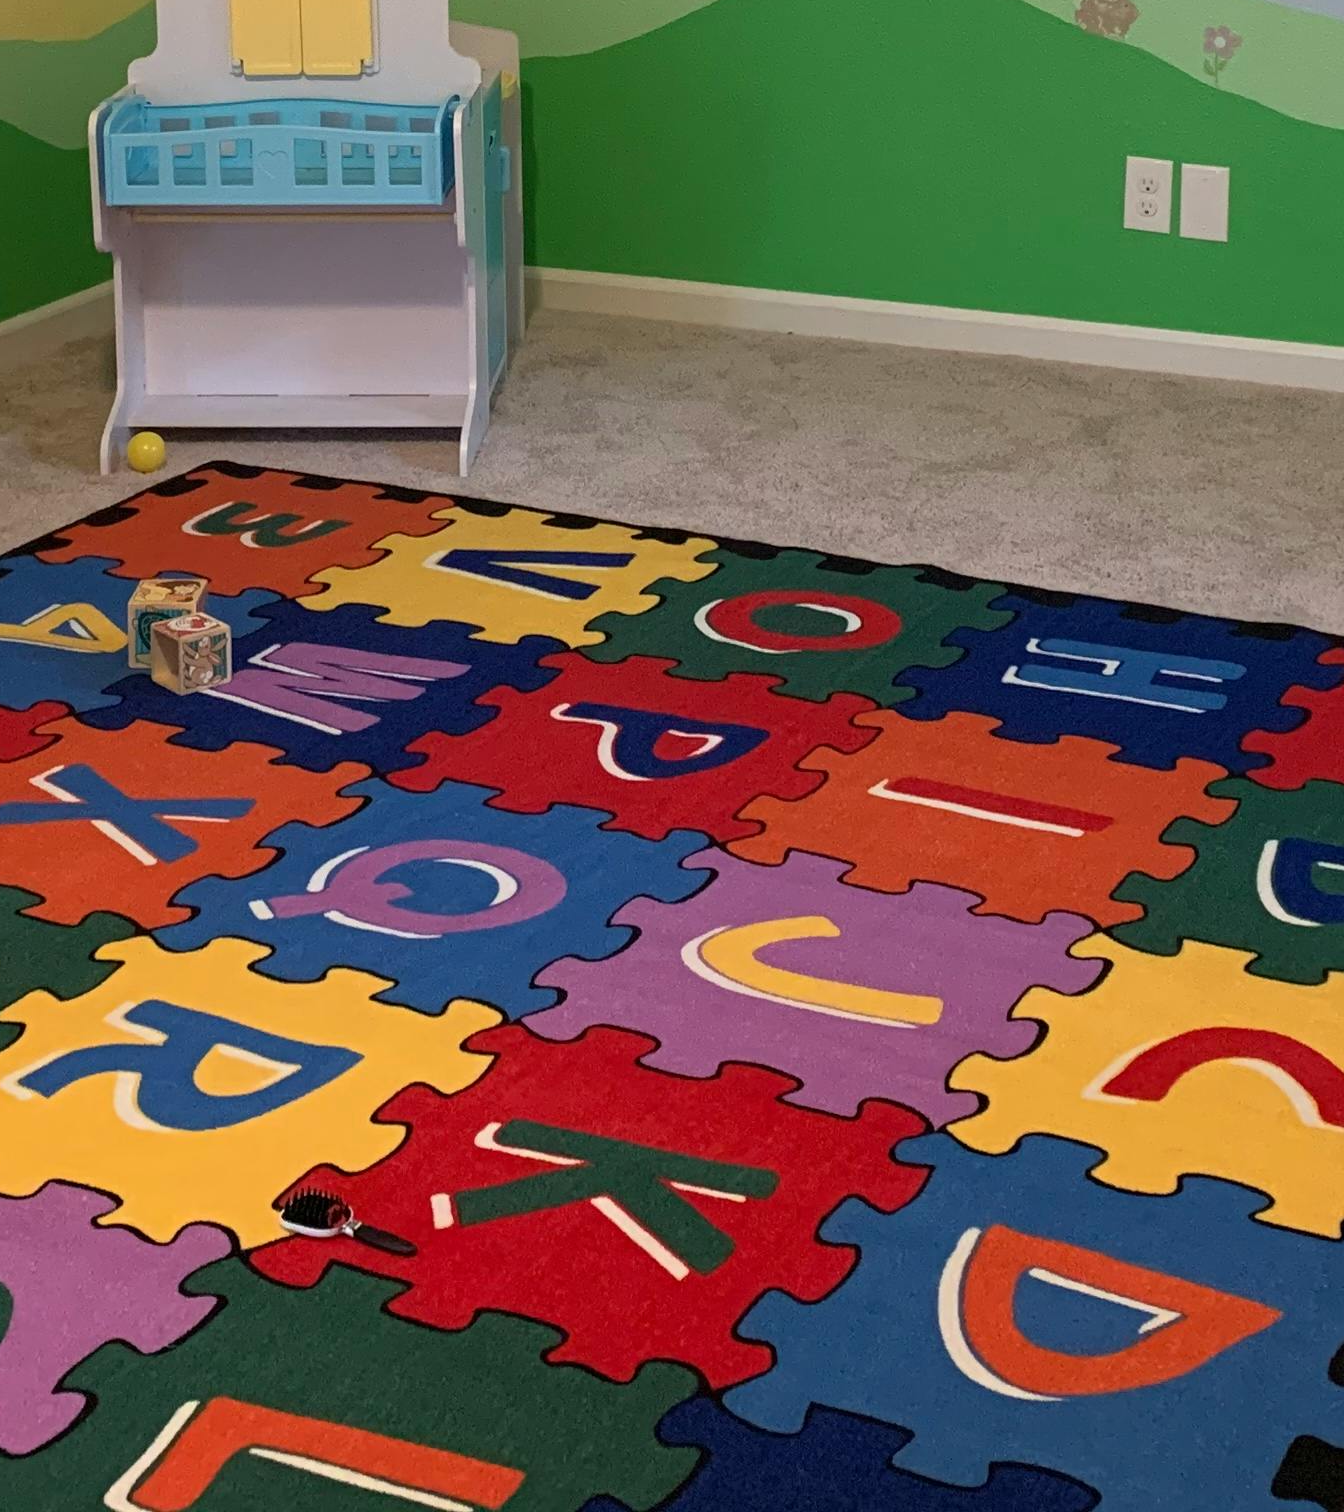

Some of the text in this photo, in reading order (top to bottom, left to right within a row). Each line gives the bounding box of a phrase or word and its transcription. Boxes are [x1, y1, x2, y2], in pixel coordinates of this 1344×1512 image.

[423, 549, 637, 601] V
[693, 590, 902, 654] O
[199, 642, 472, 735] W
[1002, 638, 1248, 714] H
[550, 702, 770, 781] P
[249, 839, 567, 939] Q
[681, 915, 944, 1028] J
[431, 1119, 780, 1281] K
[938, 1224, 1283, 1402] D
[104, 1396, 525, 1512] L
